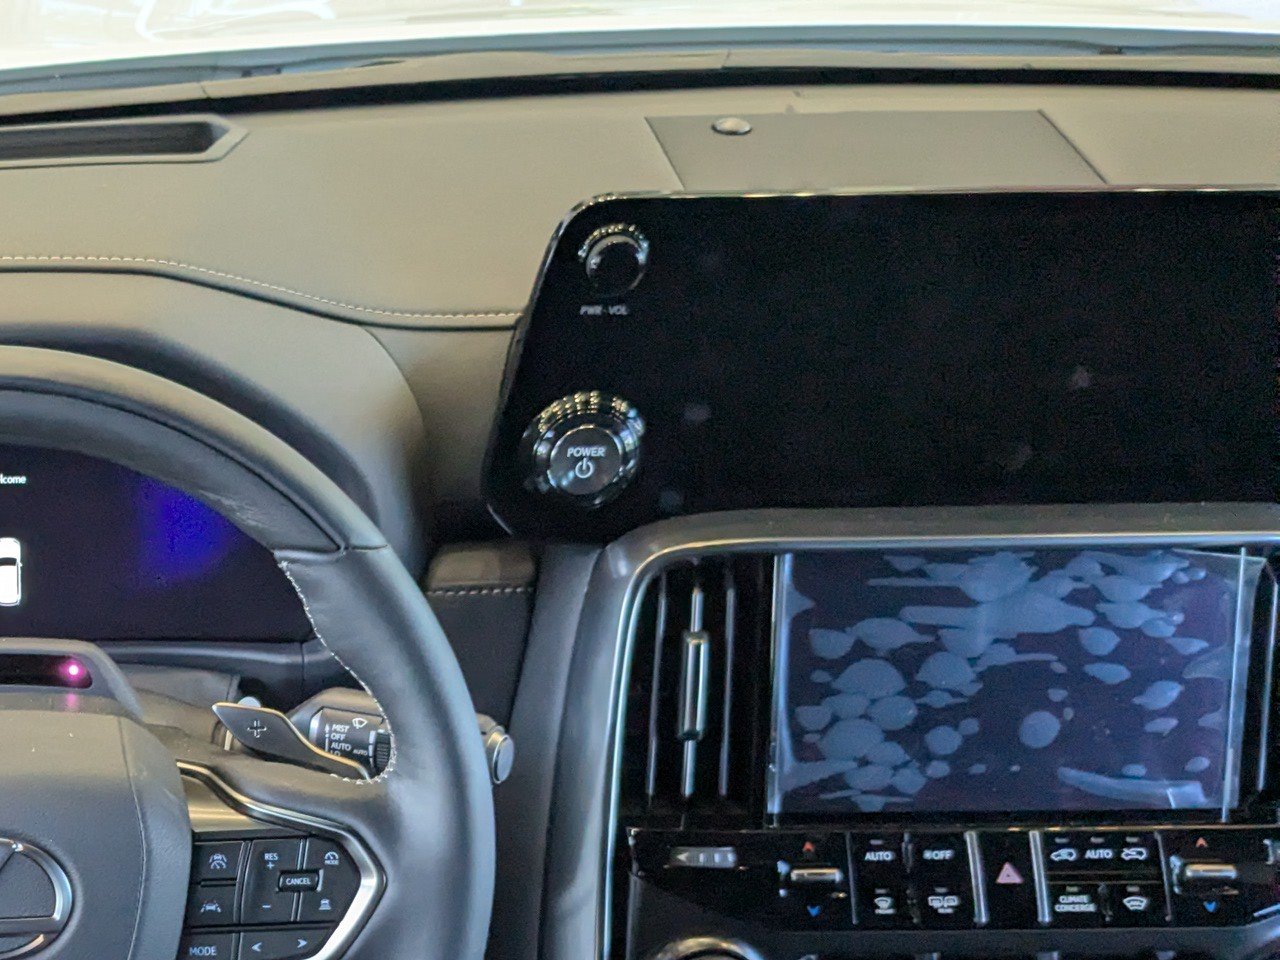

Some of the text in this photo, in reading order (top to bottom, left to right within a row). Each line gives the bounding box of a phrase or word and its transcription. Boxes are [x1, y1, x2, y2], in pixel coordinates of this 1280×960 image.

[608, 304, 627, 315] VOL
[567, 446, 606, 458] POWER
[331, 724, 350, 732] MIST
[330, 733, 346, 741] OFF
[331, 742, 351, 751] AUTO
[264, 852, 278, 861] RES
[864, 851, 895, 861] AUTO
[931, 850, 954, 860] OFF
[1084, 848, 1114, 859] AUTO
[285, 877, 311, 886] CANCEL
[189, 946, 217, 956] MODE
